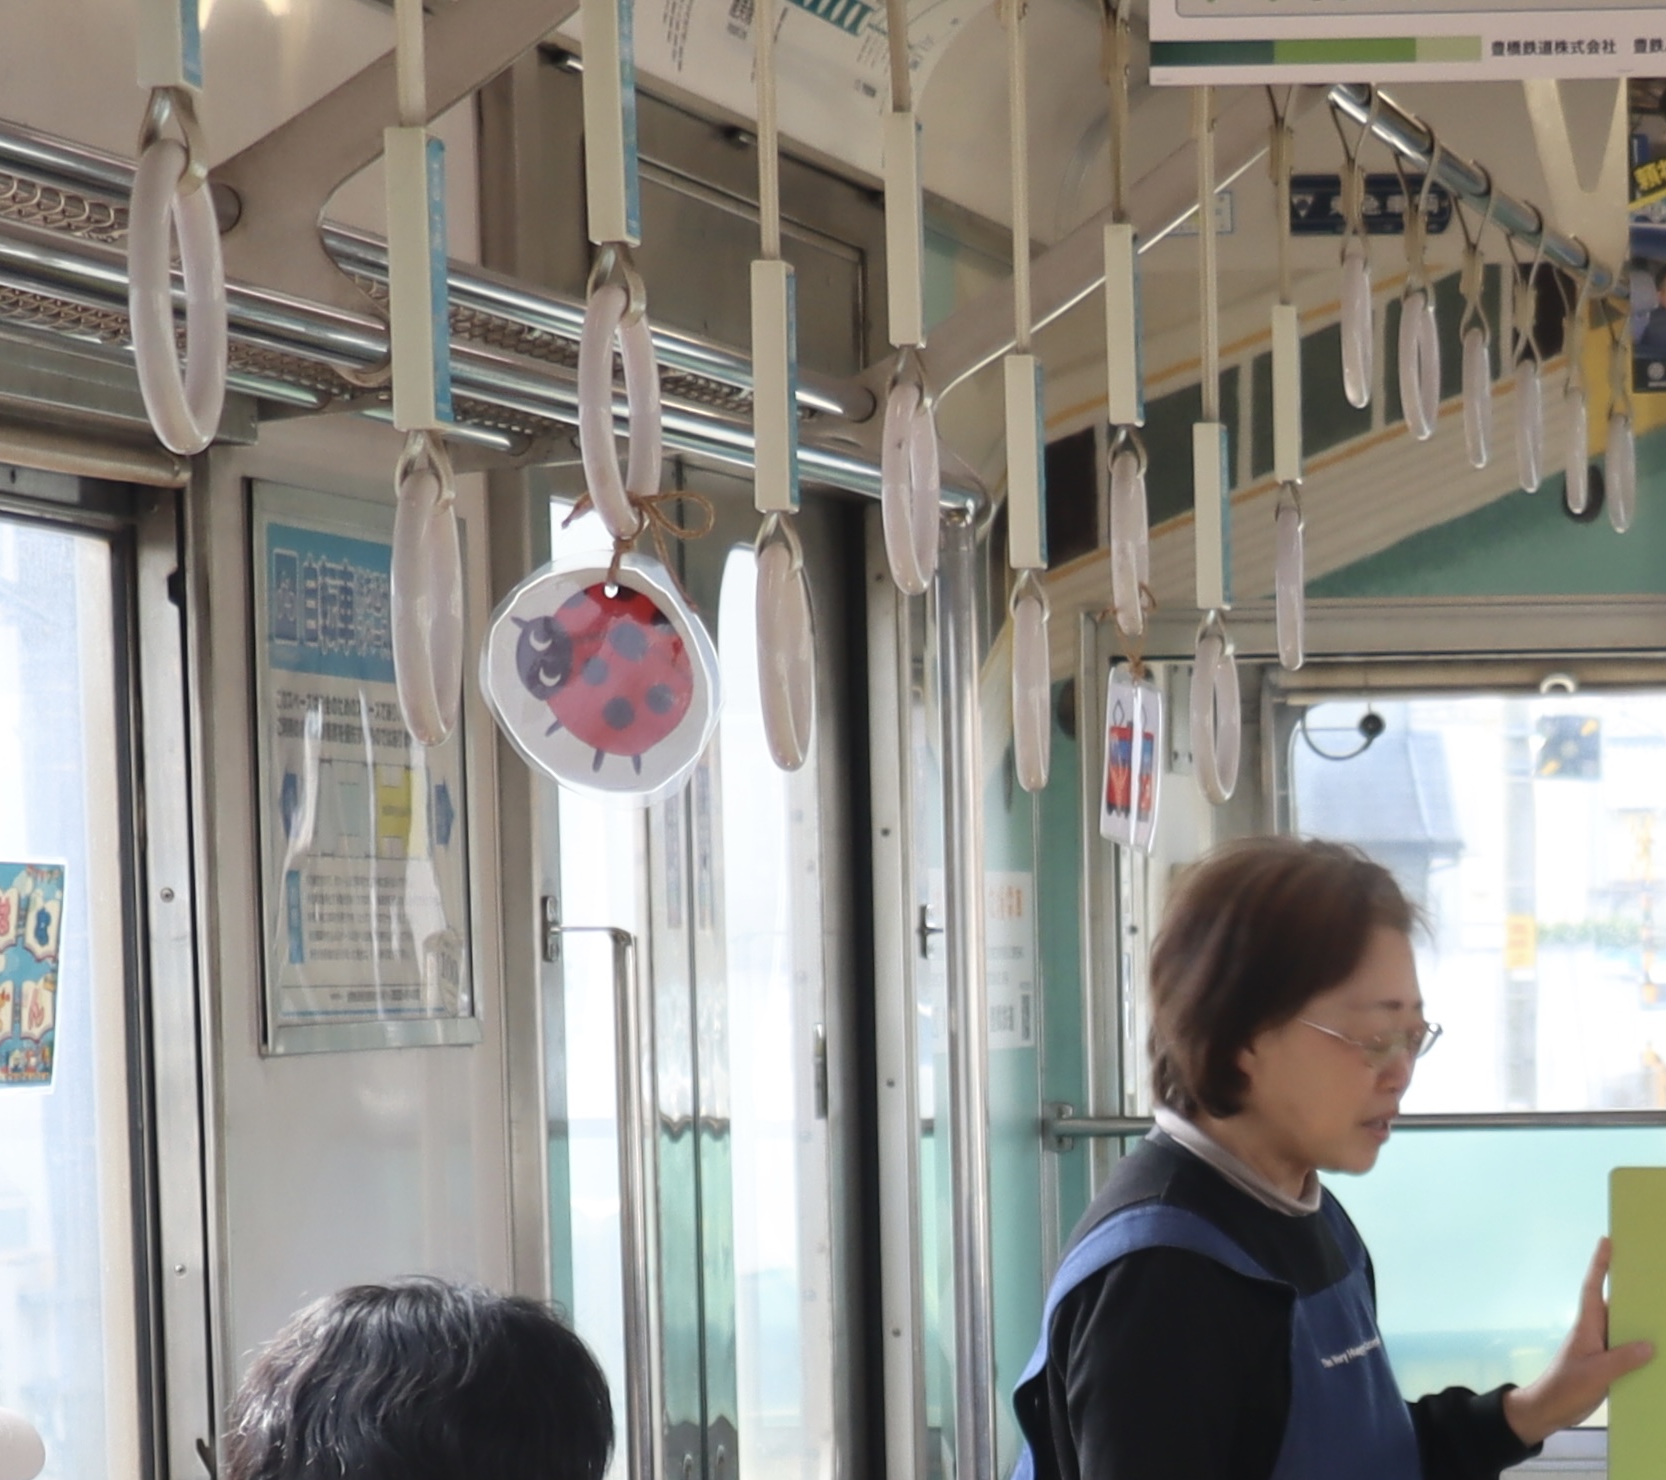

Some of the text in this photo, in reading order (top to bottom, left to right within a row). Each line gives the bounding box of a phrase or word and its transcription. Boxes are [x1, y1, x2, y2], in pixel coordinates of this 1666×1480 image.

[1491, 38, 1617, 57] 豊橋鉄道株式会社
